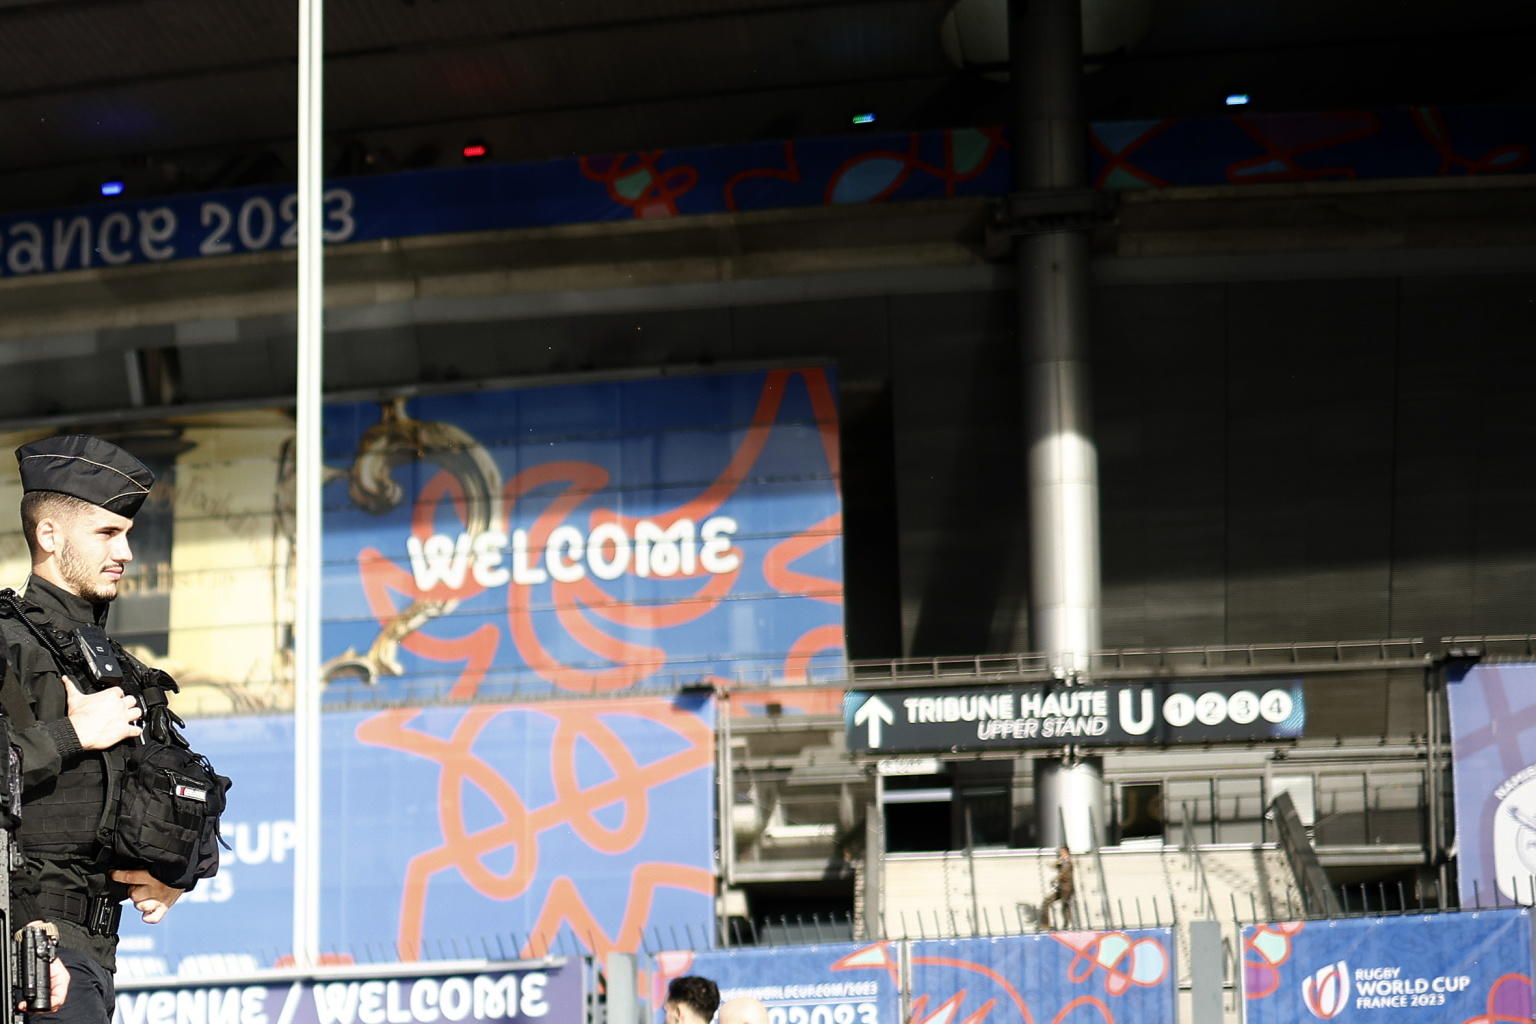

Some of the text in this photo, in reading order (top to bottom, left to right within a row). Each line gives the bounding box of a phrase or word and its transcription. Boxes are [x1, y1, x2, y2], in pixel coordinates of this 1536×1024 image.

[406, 516, 740, 592] WELCOME
[903, 694, 1014, 724] TRIBUNE
[1021, 690, 1108, 719] HAUTE
[1118, 687, 1155, 736] U
[976, 716, 1108, 741] UPPER STAND
[1354, 966, 1401, 981] RUGBY
[1355, 975, 1471, 997] WORLD CUP
[1355, 993, 1446, 1010] FRANCE 2023
